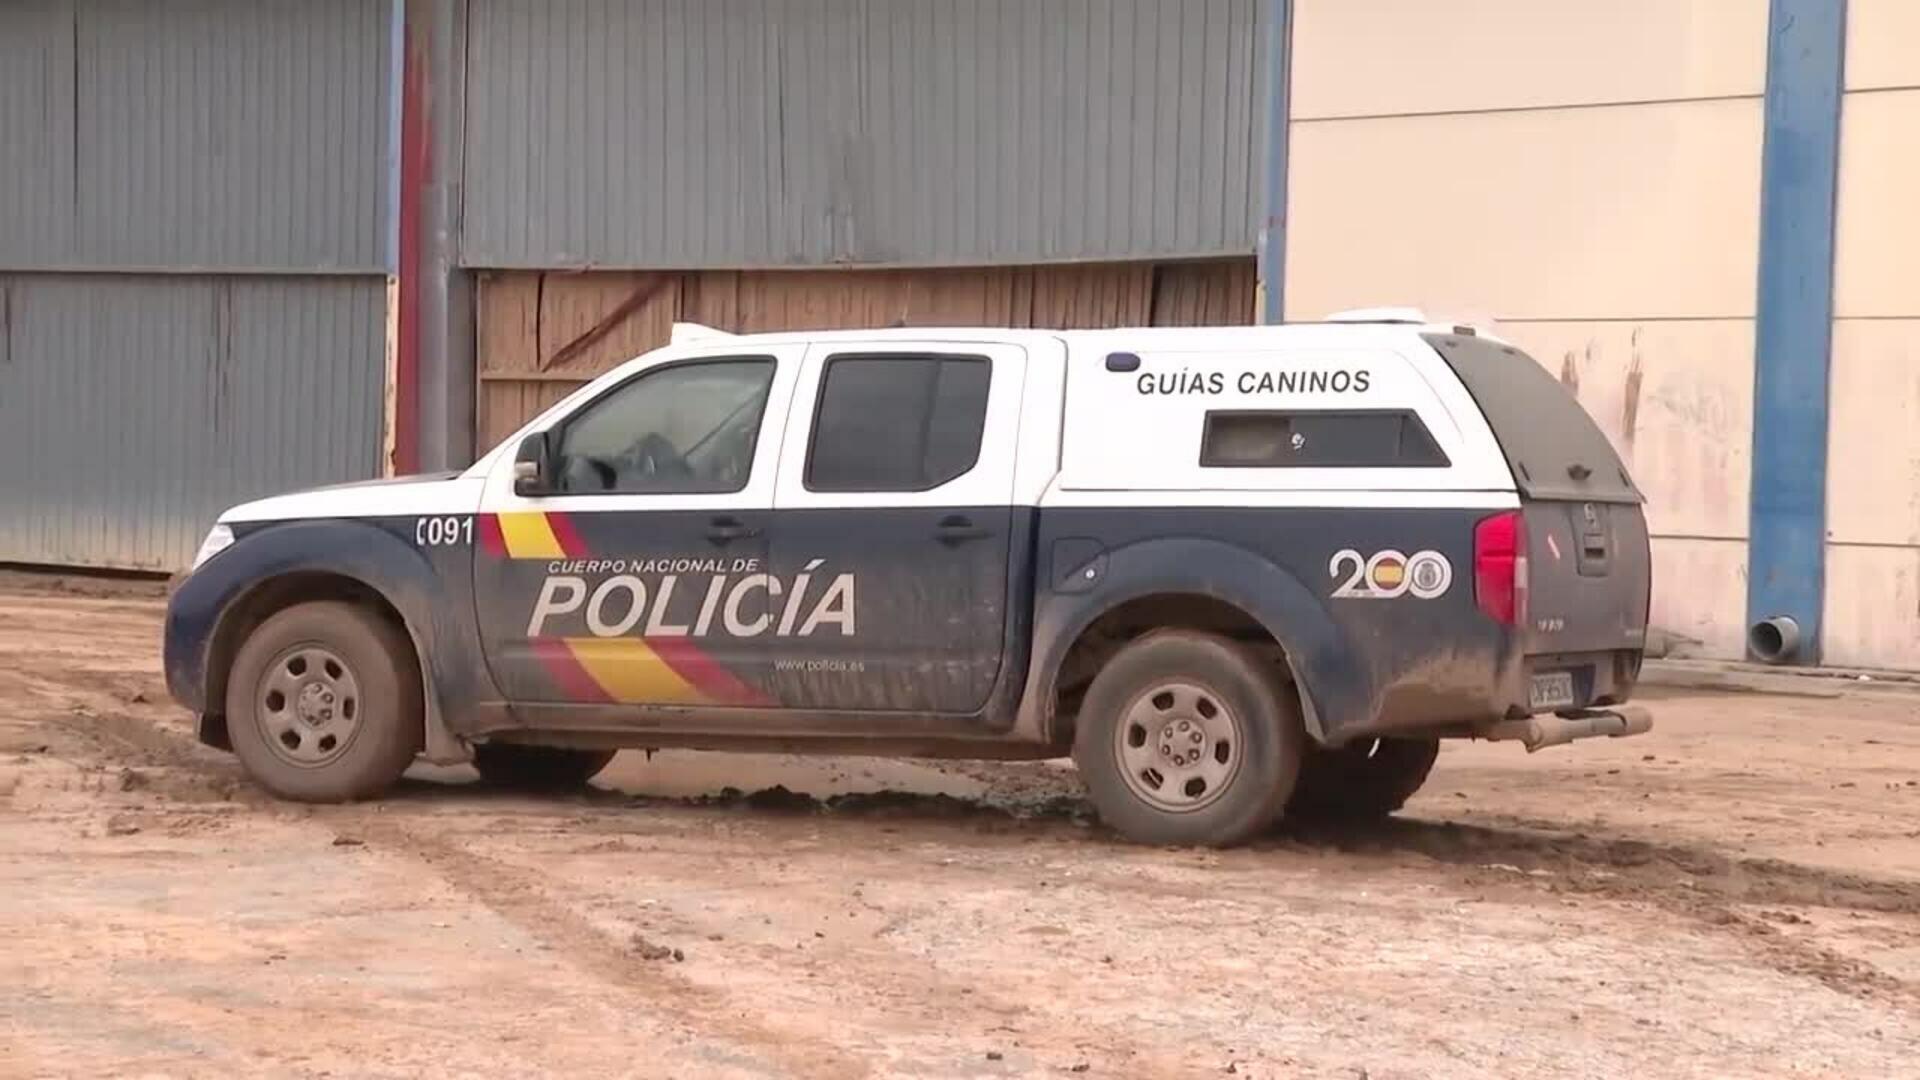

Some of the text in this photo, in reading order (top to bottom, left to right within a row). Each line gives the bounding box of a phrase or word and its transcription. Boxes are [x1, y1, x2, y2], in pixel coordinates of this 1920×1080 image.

[1137, 367, 1370, 395] GUÍAS CANINOS
[548, 558, 759, 574] CUERPO NACIONAL DE
[1329, 549, 1452, 600] 200
[527, 559, 856, 637] POLICÍA
